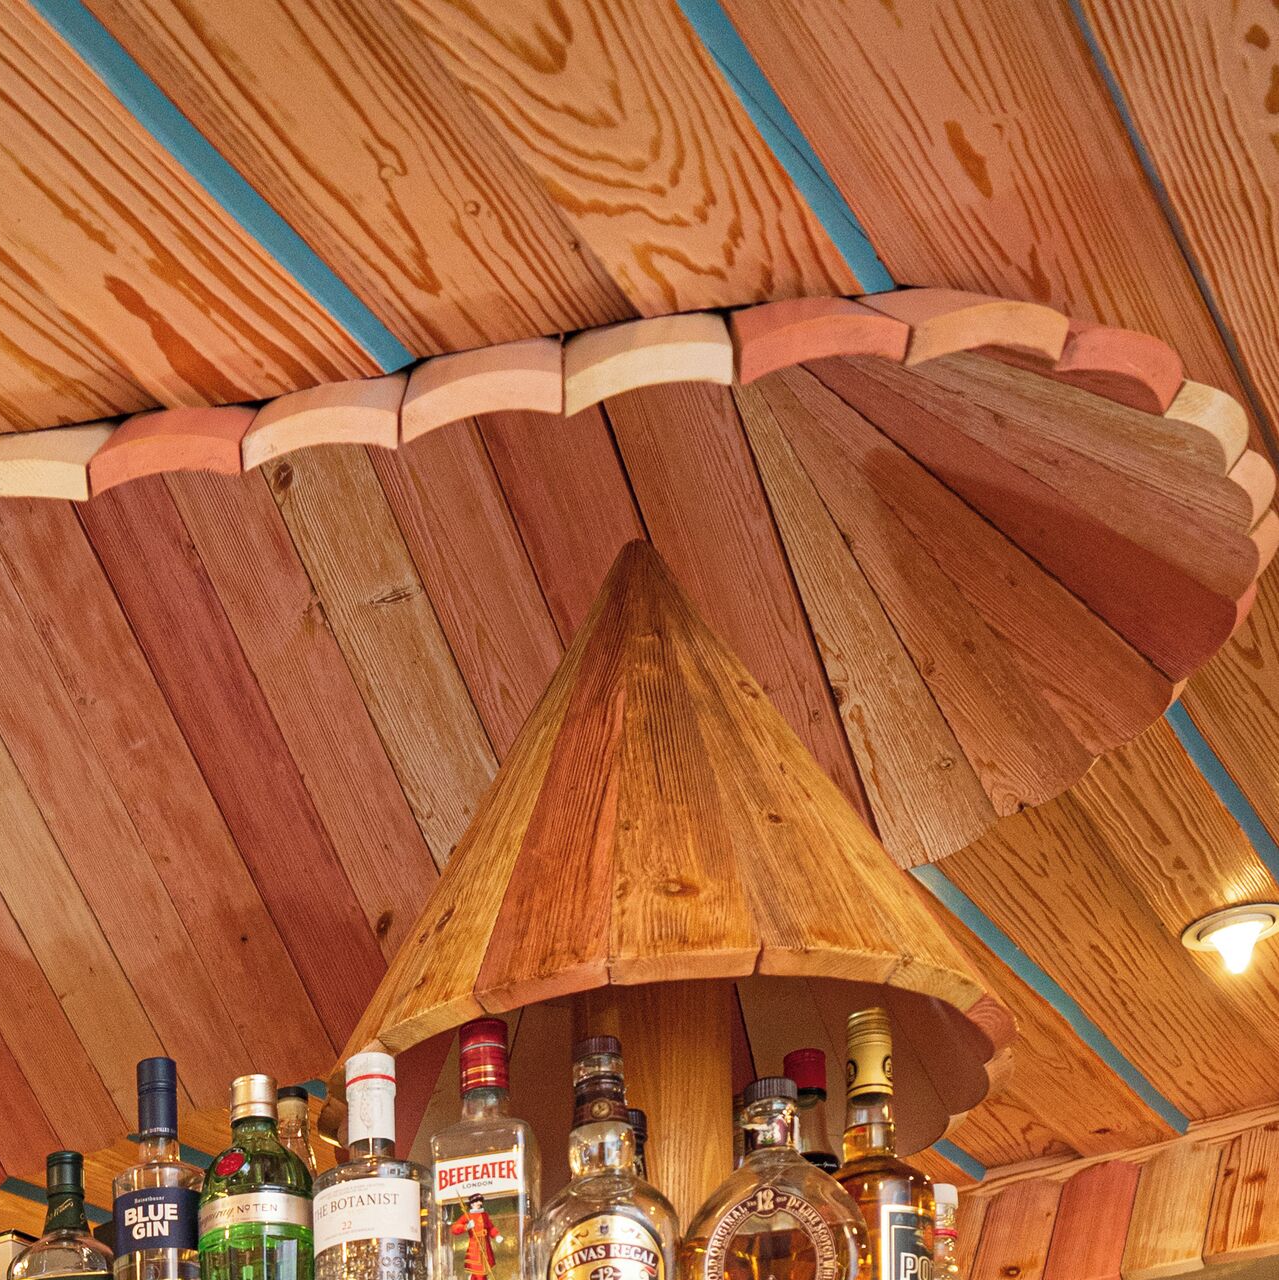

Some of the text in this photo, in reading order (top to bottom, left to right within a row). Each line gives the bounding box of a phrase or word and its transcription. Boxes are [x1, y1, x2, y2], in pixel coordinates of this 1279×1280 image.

[437, 1158, 519, 1192] BEEFEATER
[462, 1179, 493, 1190] LONDON
[124, 1203, 179, 1227] BLUE
[252, 1202, 279, 1213] TEN
[330, 1192, 400, 1215] BOTANIST
[132, 1220, 170, 1240] GIN
[710, 1204, 749, 1258] ORIGINAL
[554, 1243, 657, 1278] CHIVAS REGAL
